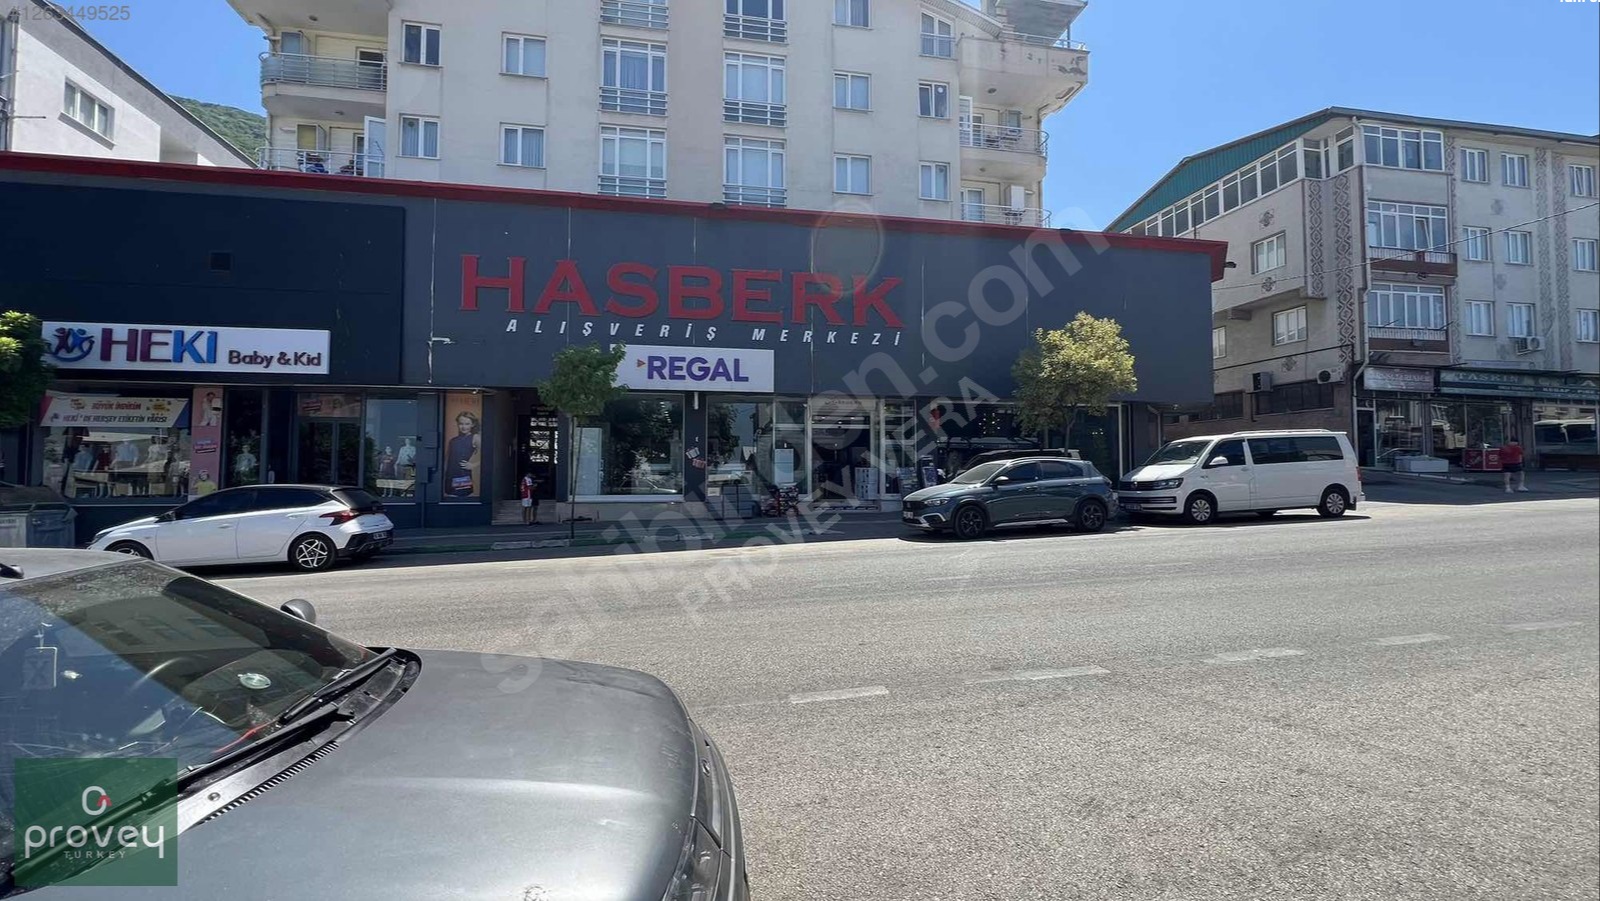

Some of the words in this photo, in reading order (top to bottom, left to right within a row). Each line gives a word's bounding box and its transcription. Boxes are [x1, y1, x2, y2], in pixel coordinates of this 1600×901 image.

[459, 254, 905, 327] HASBERK
[505, 319, 717, 341] ALIŞVERİŞ
[751, 328, 902, 346] MERKEZİ
[228, 349, 274, 369] Baby
[277, 351, 292, 366] &
[293, 352, 321, 367] Kid
[646, 354, 749, 382] REGAL
